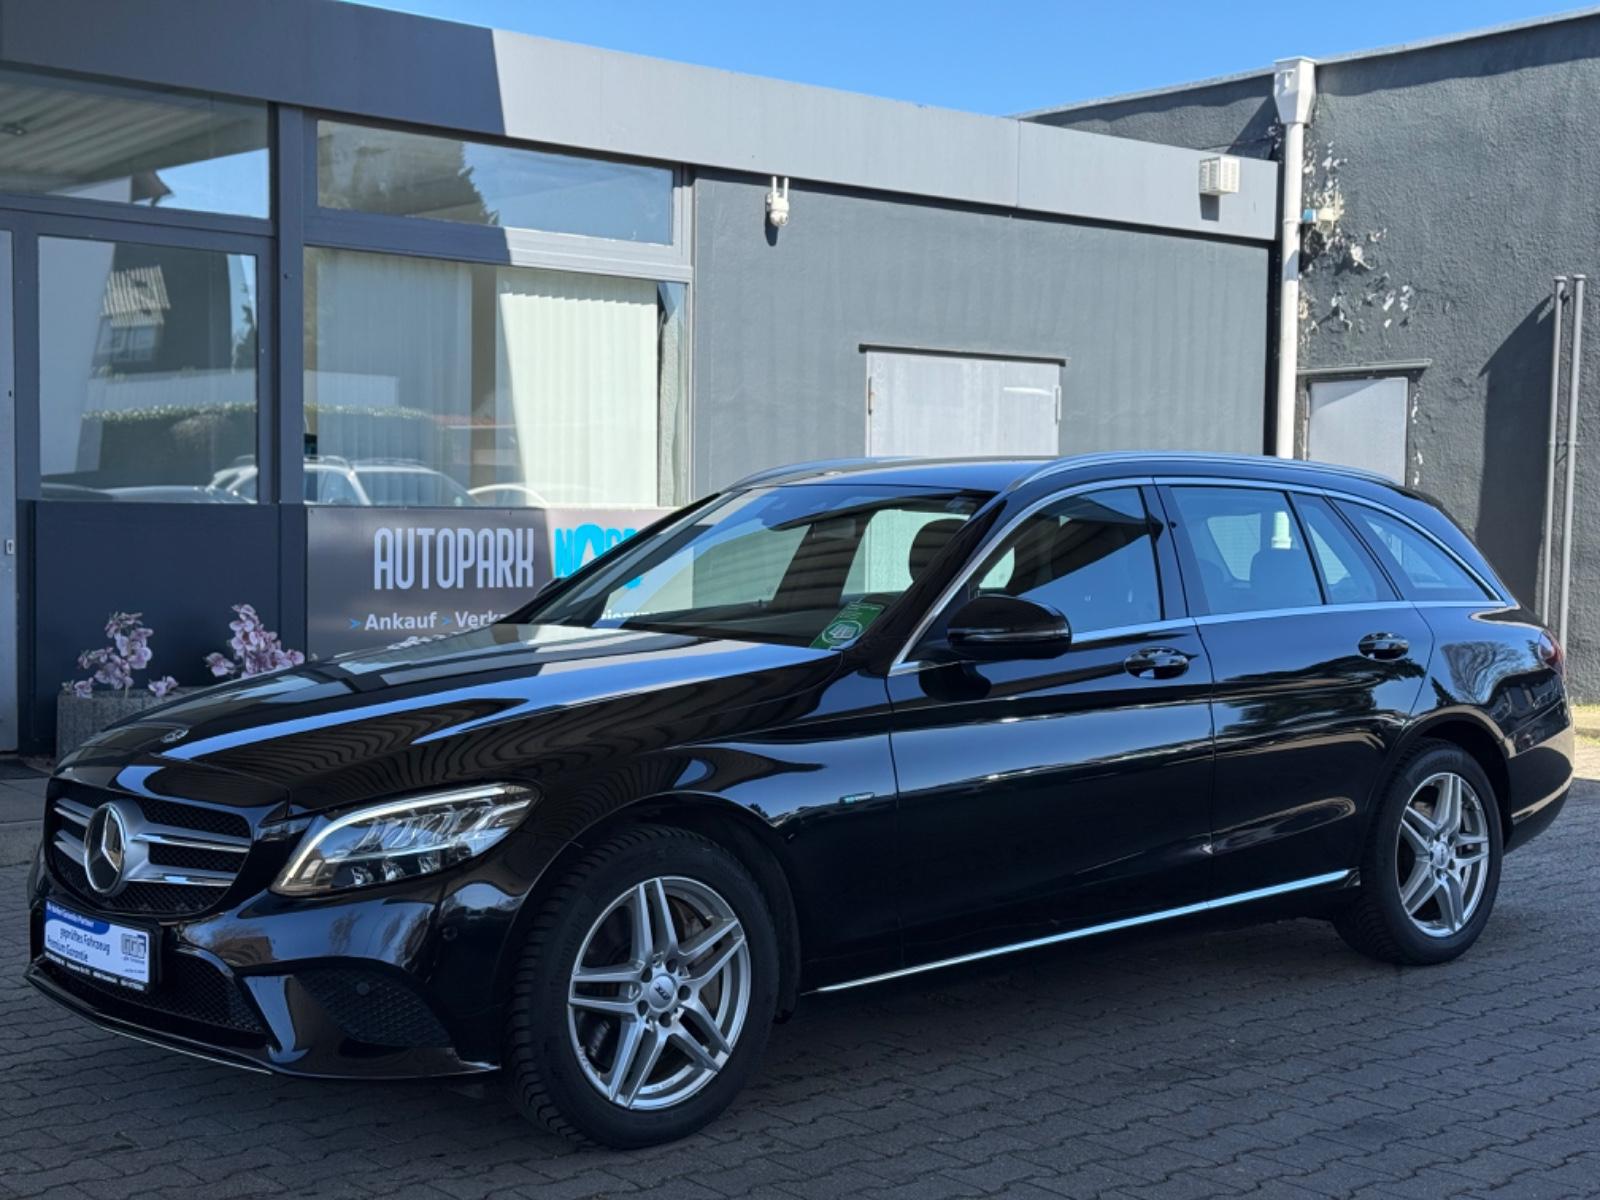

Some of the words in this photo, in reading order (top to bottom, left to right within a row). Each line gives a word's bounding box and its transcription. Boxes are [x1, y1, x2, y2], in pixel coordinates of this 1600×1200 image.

[373, 527, 534, 589] AUTOPARK
[554, 521, 641, 580] NO
[364, 611, 438, 630] Ankauf
